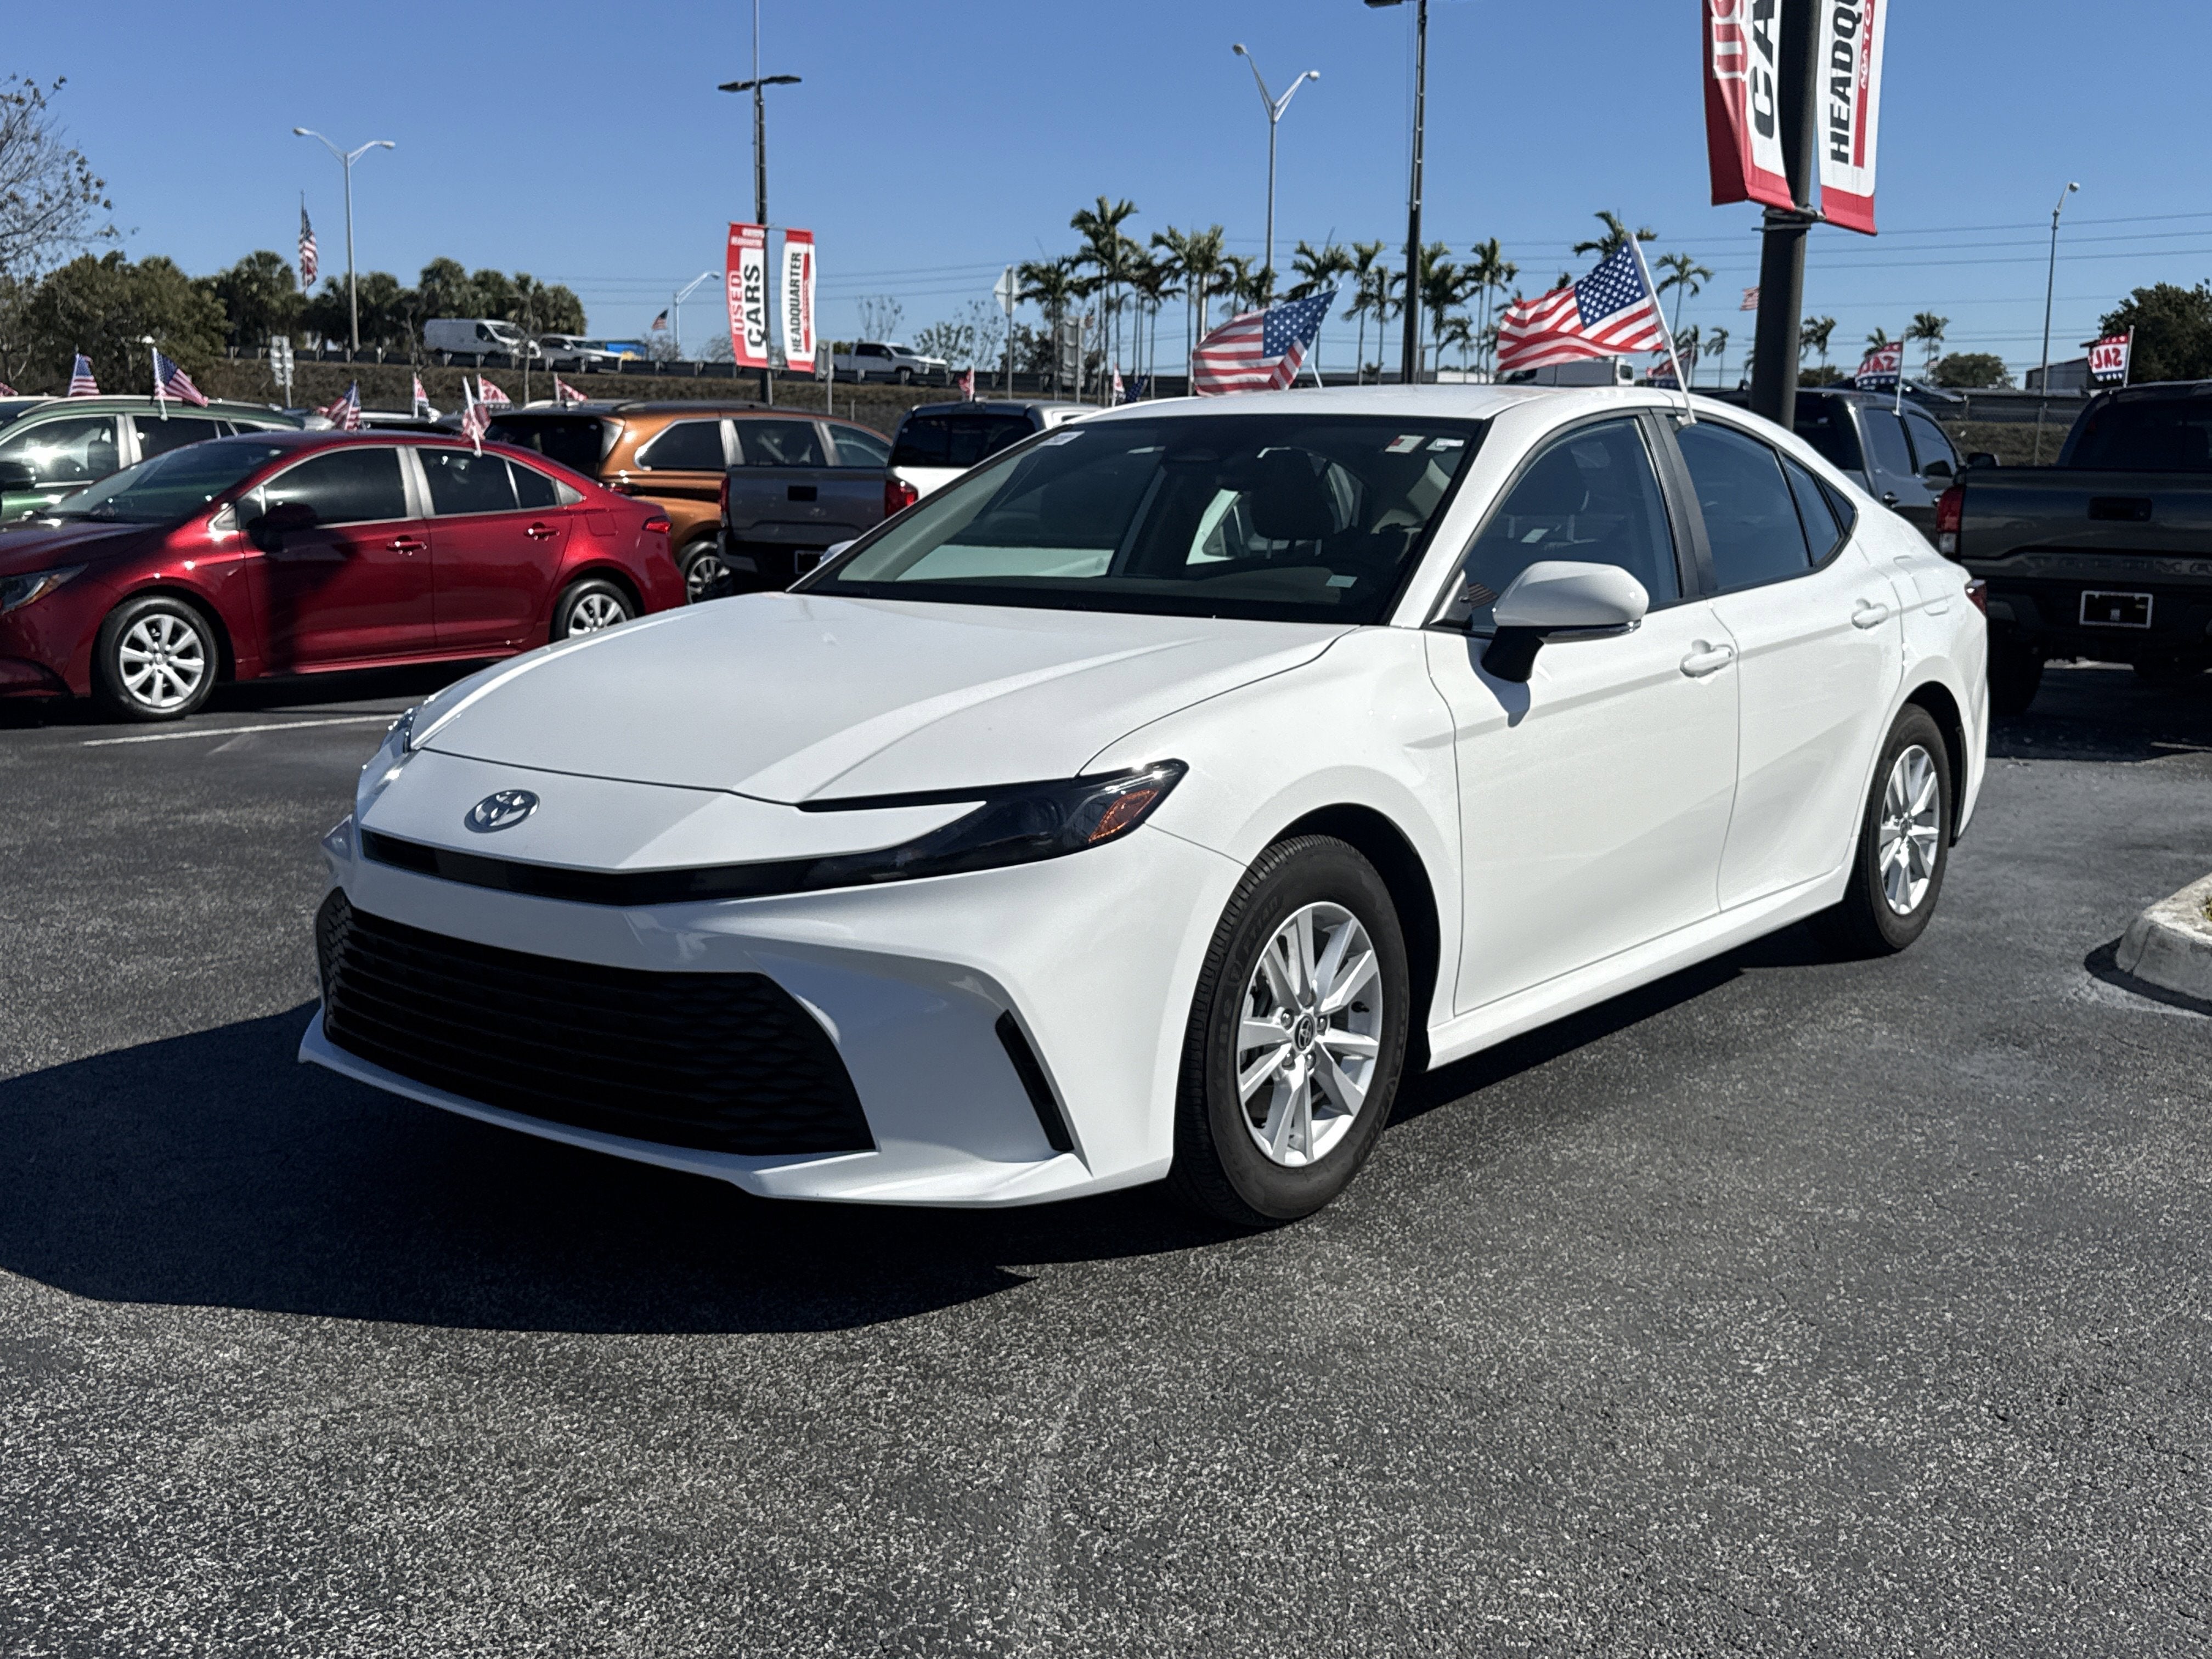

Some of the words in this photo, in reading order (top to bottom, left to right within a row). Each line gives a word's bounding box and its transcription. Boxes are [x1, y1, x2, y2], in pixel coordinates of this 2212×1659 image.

[1830, 0, 1863, 165] HEADQ
[730, 272, 745, 333] USED
[744, 264, 765, 347] CARS
[788, 252, 803, 353] HEADQUARTER
